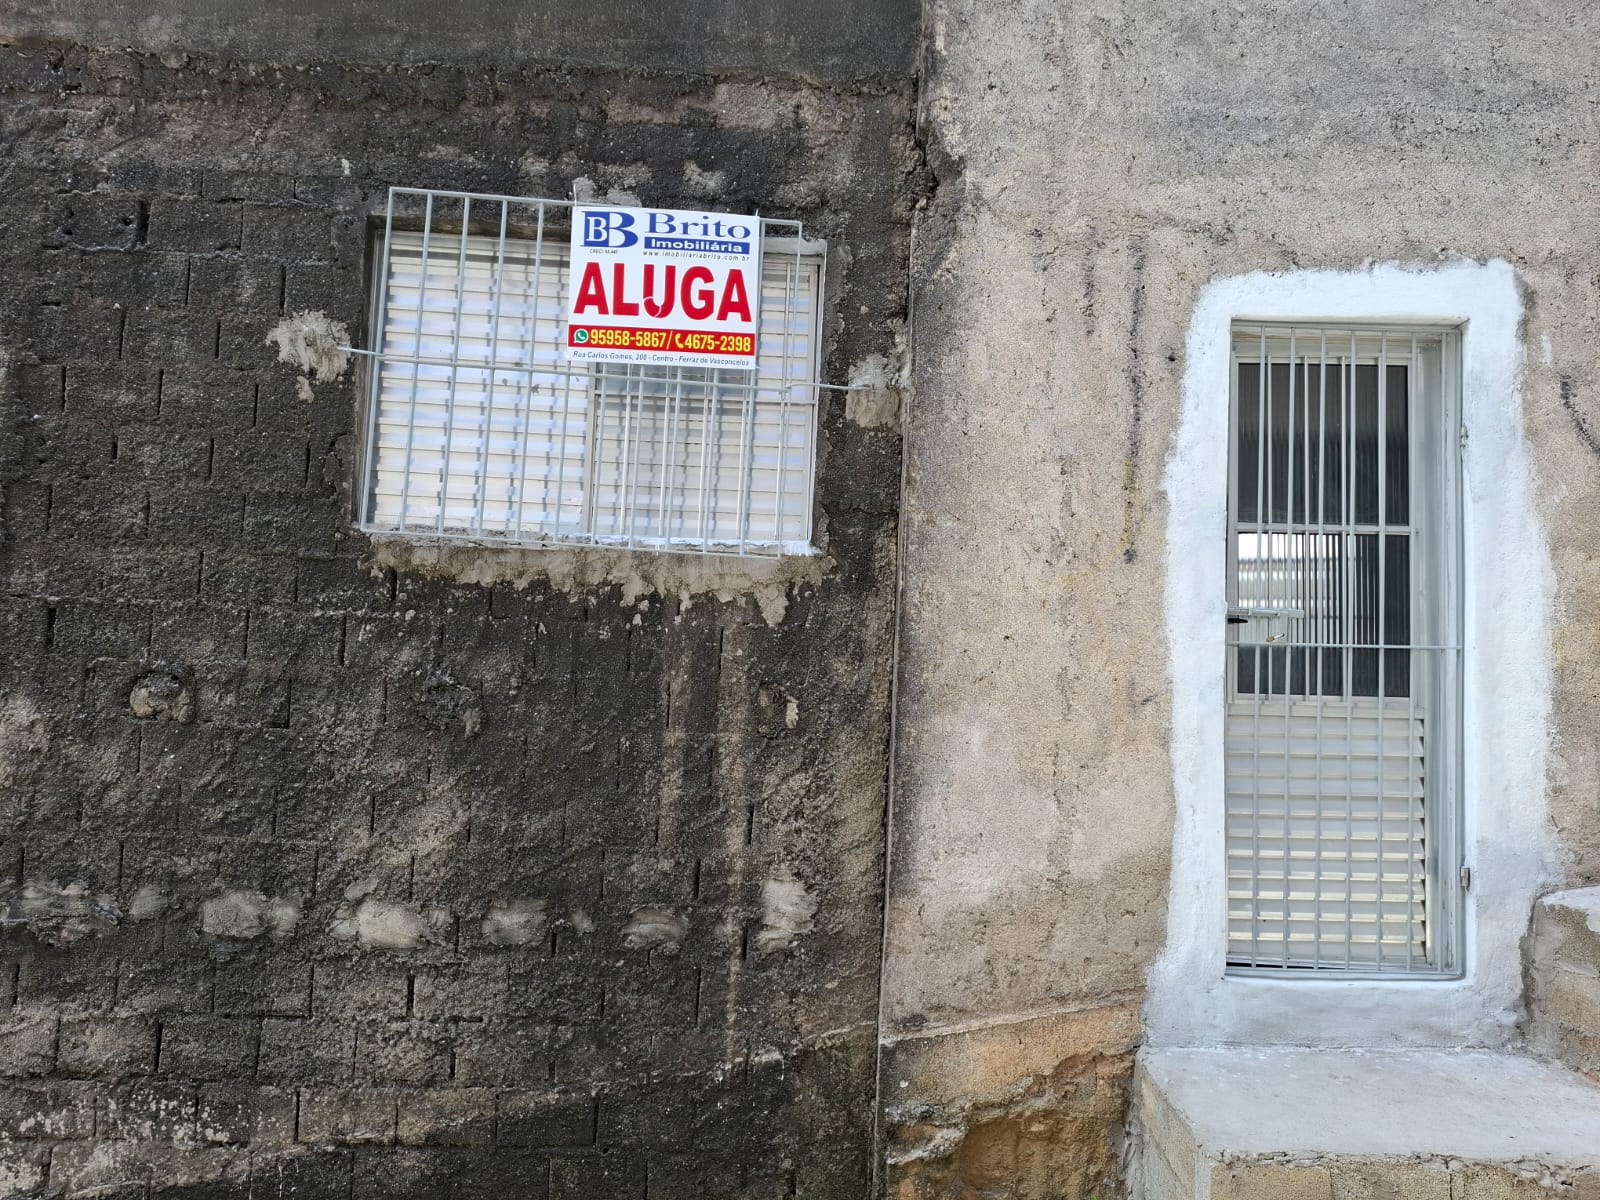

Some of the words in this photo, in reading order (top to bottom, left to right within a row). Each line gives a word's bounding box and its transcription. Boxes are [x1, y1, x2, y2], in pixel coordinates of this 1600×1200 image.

[645, 212, 751, 239] Brito
[651, 238, 743, 253] Imobiliária
[642, 250, 751, 261] www.imobiliariabrito.com.br
[573, 262, 752, 322] ALUGA
[684, 334, 752, 352] 4675-2398
[572, 350, 586, 358] Rua
[587, 351, 609, 360] Carlos
[609, 352, 634, 361] Gomes,
[652, 354, 674, 362] Centro
[678, 355, 699, 363] Ferraz
[709, 357, 749, 366] Vasconcelos
